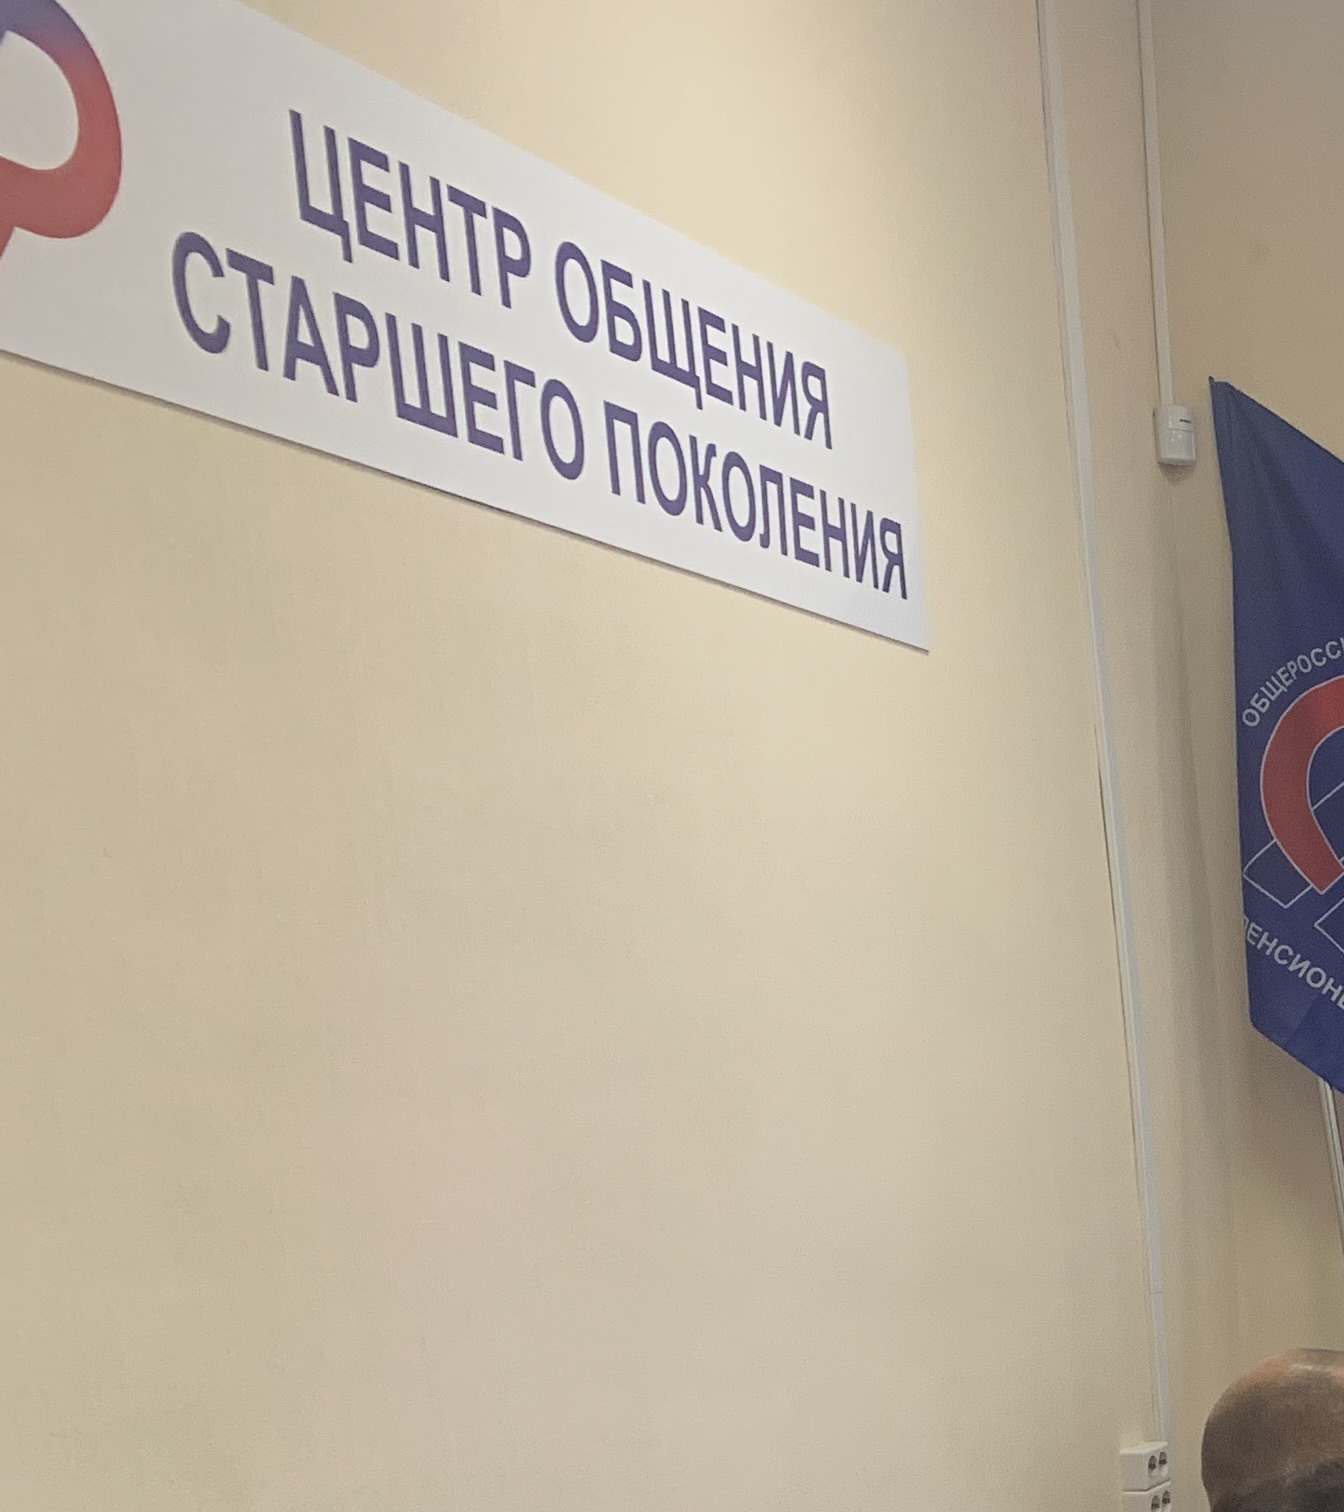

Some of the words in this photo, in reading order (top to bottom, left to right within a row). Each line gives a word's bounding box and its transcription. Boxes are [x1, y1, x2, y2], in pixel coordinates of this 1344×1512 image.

[172, 231, 585, 480] СТАРШЕГО
[603, 401, 908, 600] ПОКОЛЕНИЯ
[289, 109, 532, 309] ЦЕНТР
[556, 241, 833, 449] ОБЩЕНИЯ
